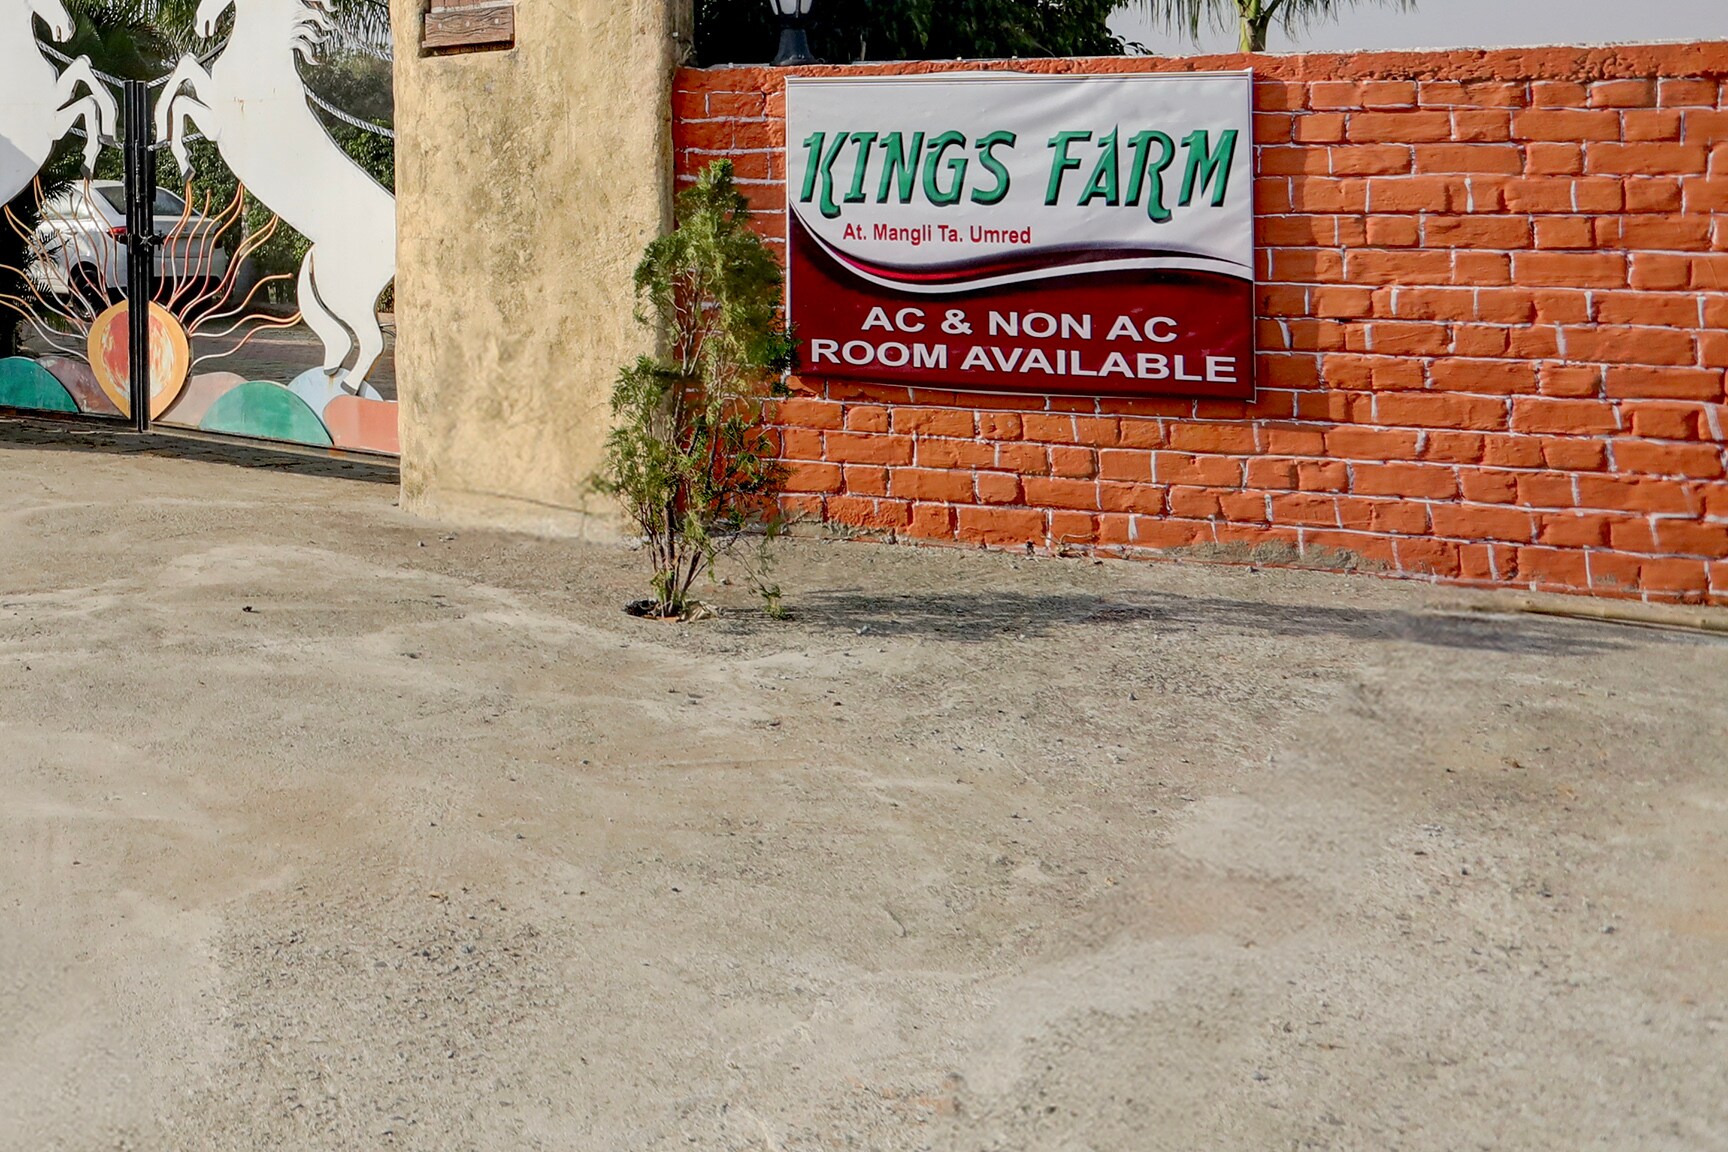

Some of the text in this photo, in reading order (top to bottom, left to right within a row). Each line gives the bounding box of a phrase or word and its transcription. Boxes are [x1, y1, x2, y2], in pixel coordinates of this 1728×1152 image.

[799, 124, 1238, 223] KINGS FARM
[843, 224, 1031, 245] At. Mangli Ta. Umred
[861, 307, 1177, 342] AC & NON AC
[811, 339, 1237, 383] ROOM AVAILABLE
